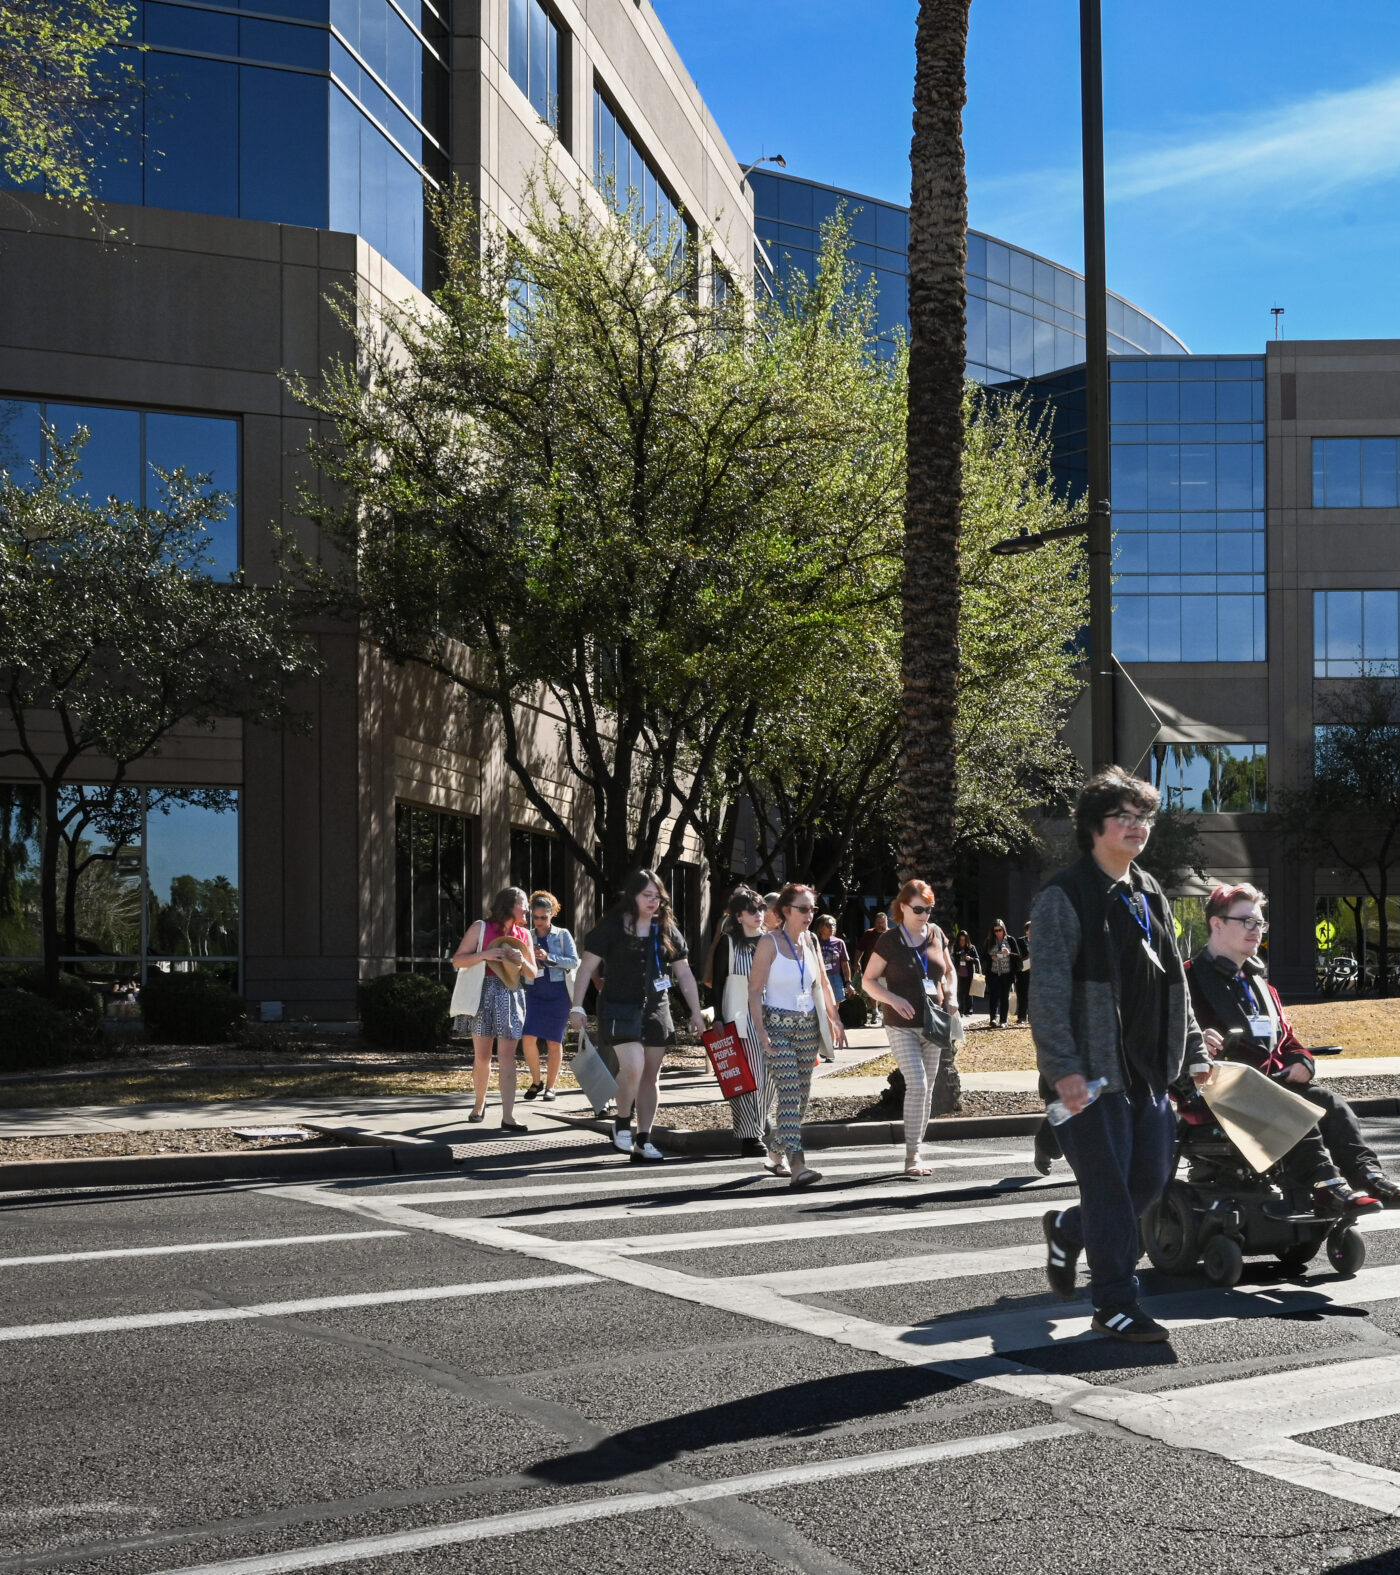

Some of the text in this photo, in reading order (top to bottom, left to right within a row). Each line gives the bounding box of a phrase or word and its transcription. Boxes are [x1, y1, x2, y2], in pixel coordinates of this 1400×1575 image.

[710, 1036, 734, 1051] PROTECT
[713, 1047, 736, 1061] PEOPLE,
[717, 1060, 729, 1070] NOT
[720, 1067, 741, 1080] POWER
